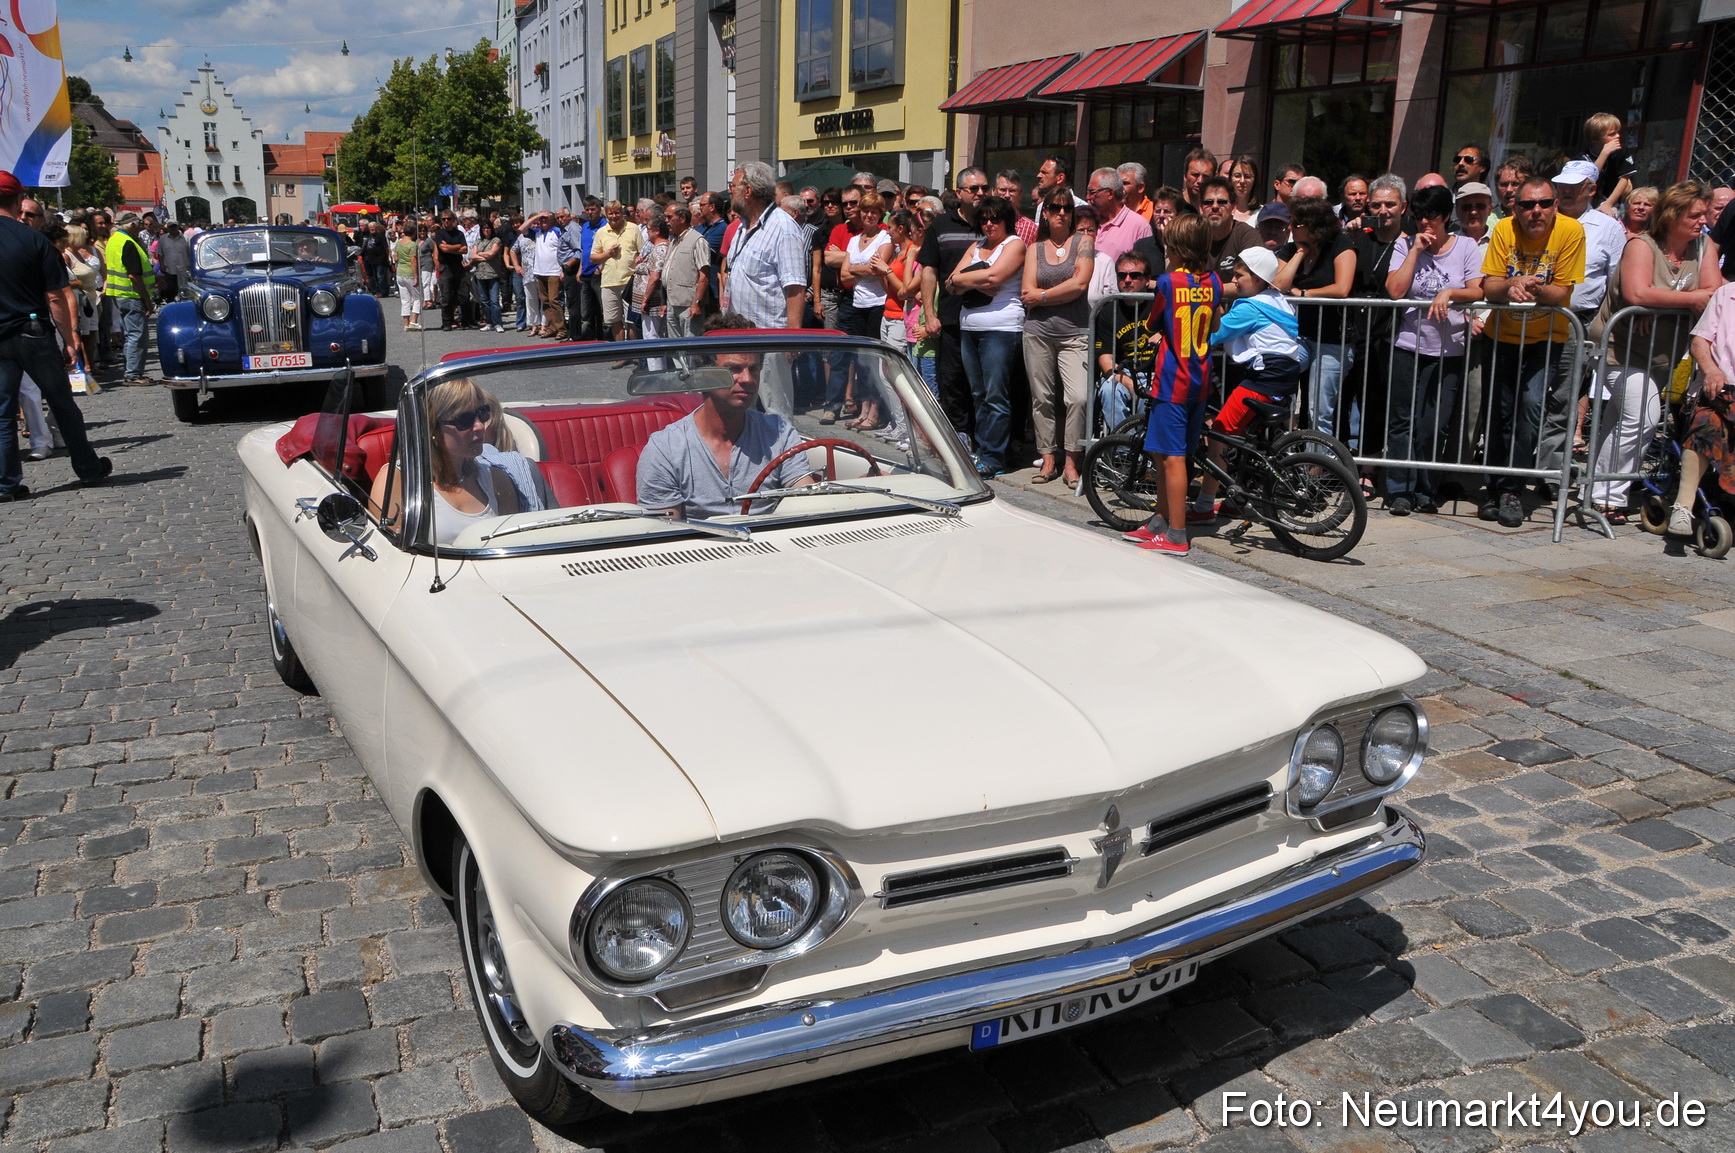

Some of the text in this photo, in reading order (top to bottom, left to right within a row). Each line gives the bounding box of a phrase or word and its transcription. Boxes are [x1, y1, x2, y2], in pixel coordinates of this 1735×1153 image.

[814, 108, 874, 134] GERRY WEBER
[1175, 287, 1213, 303] MESSI
[1175, 305, 1213, 358] 10
[253, 354, 306, 367] R 07515
[981, 1025, 992, 1038] D
